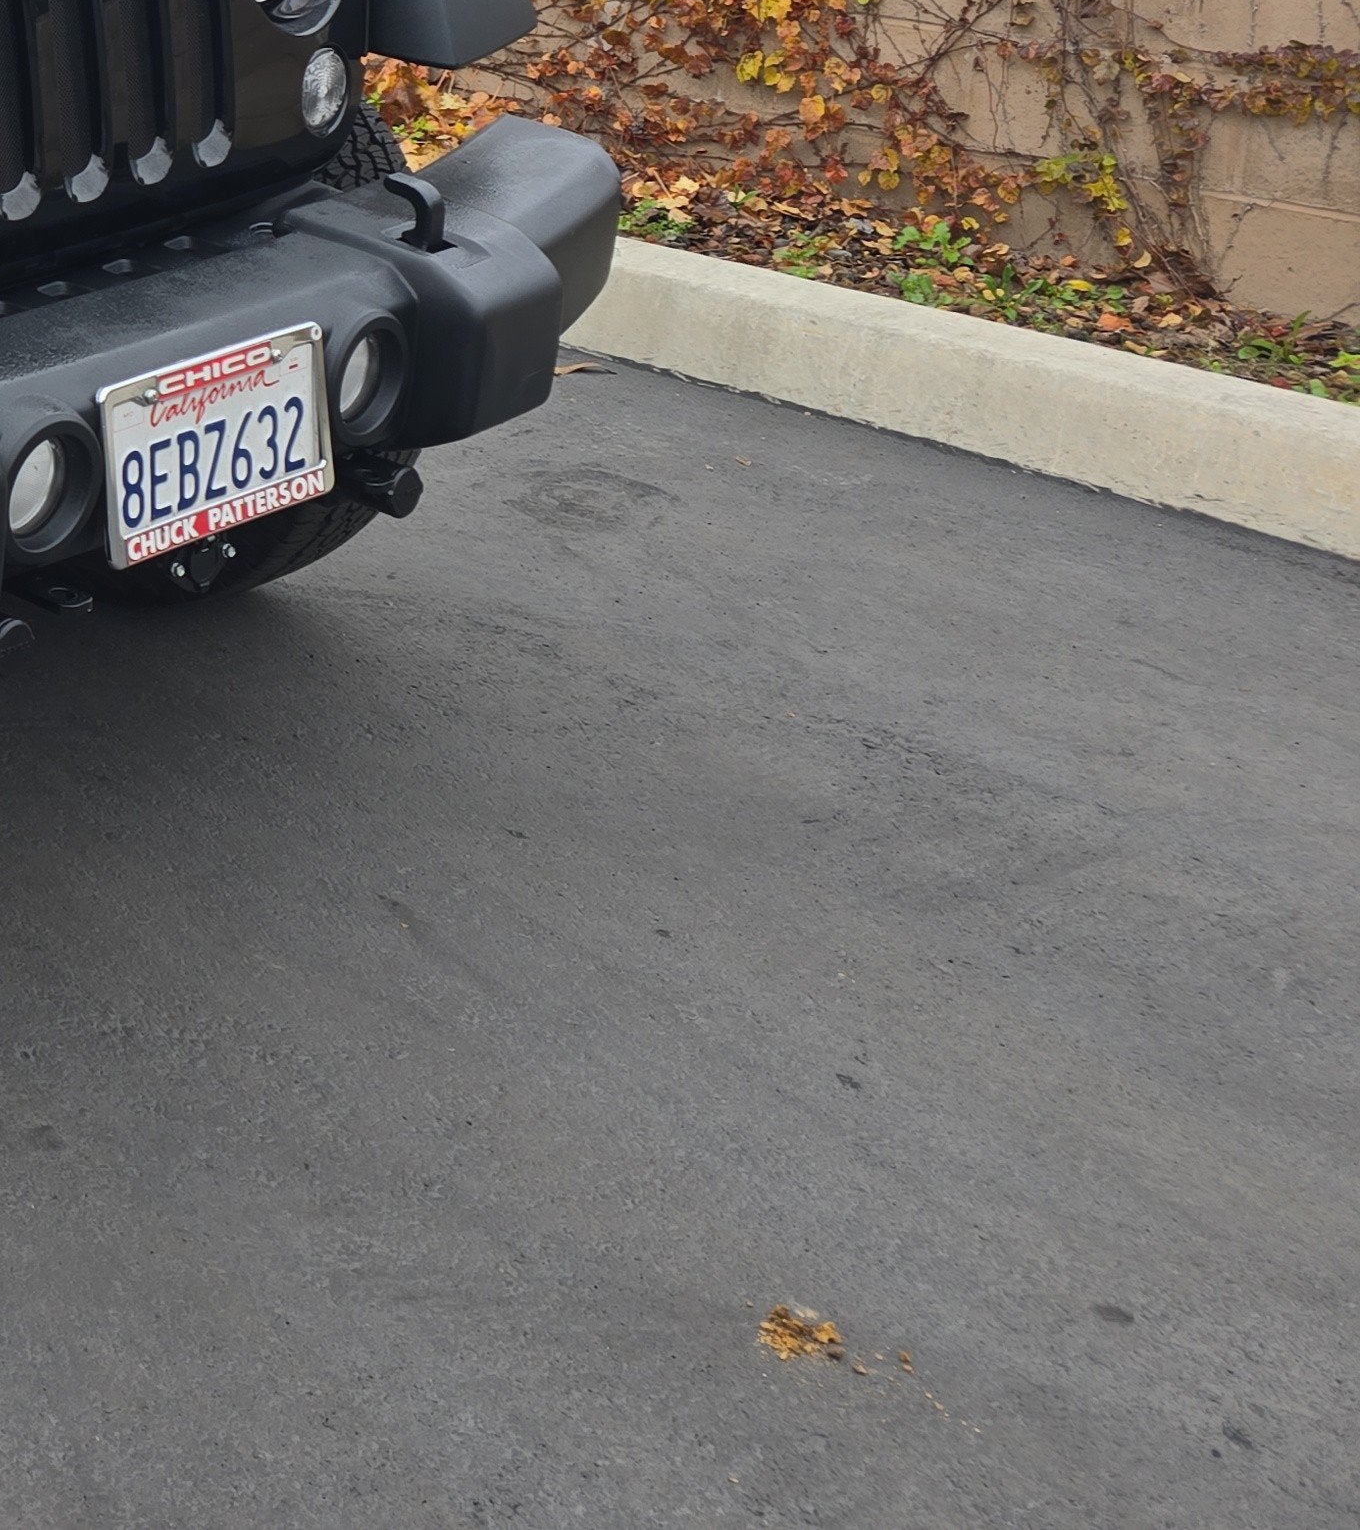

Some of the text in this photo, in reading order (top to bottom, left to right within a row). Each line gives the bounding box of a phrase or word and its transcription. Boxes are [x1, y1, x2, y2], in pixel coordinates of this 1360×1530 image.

[149, 369, 280, 428] California
[158, 345, 272, 396] CHICO
[121, 396, 306, 530] 8EBZ632
[127, 470, 325, 562] CHUCK PATTERSON
